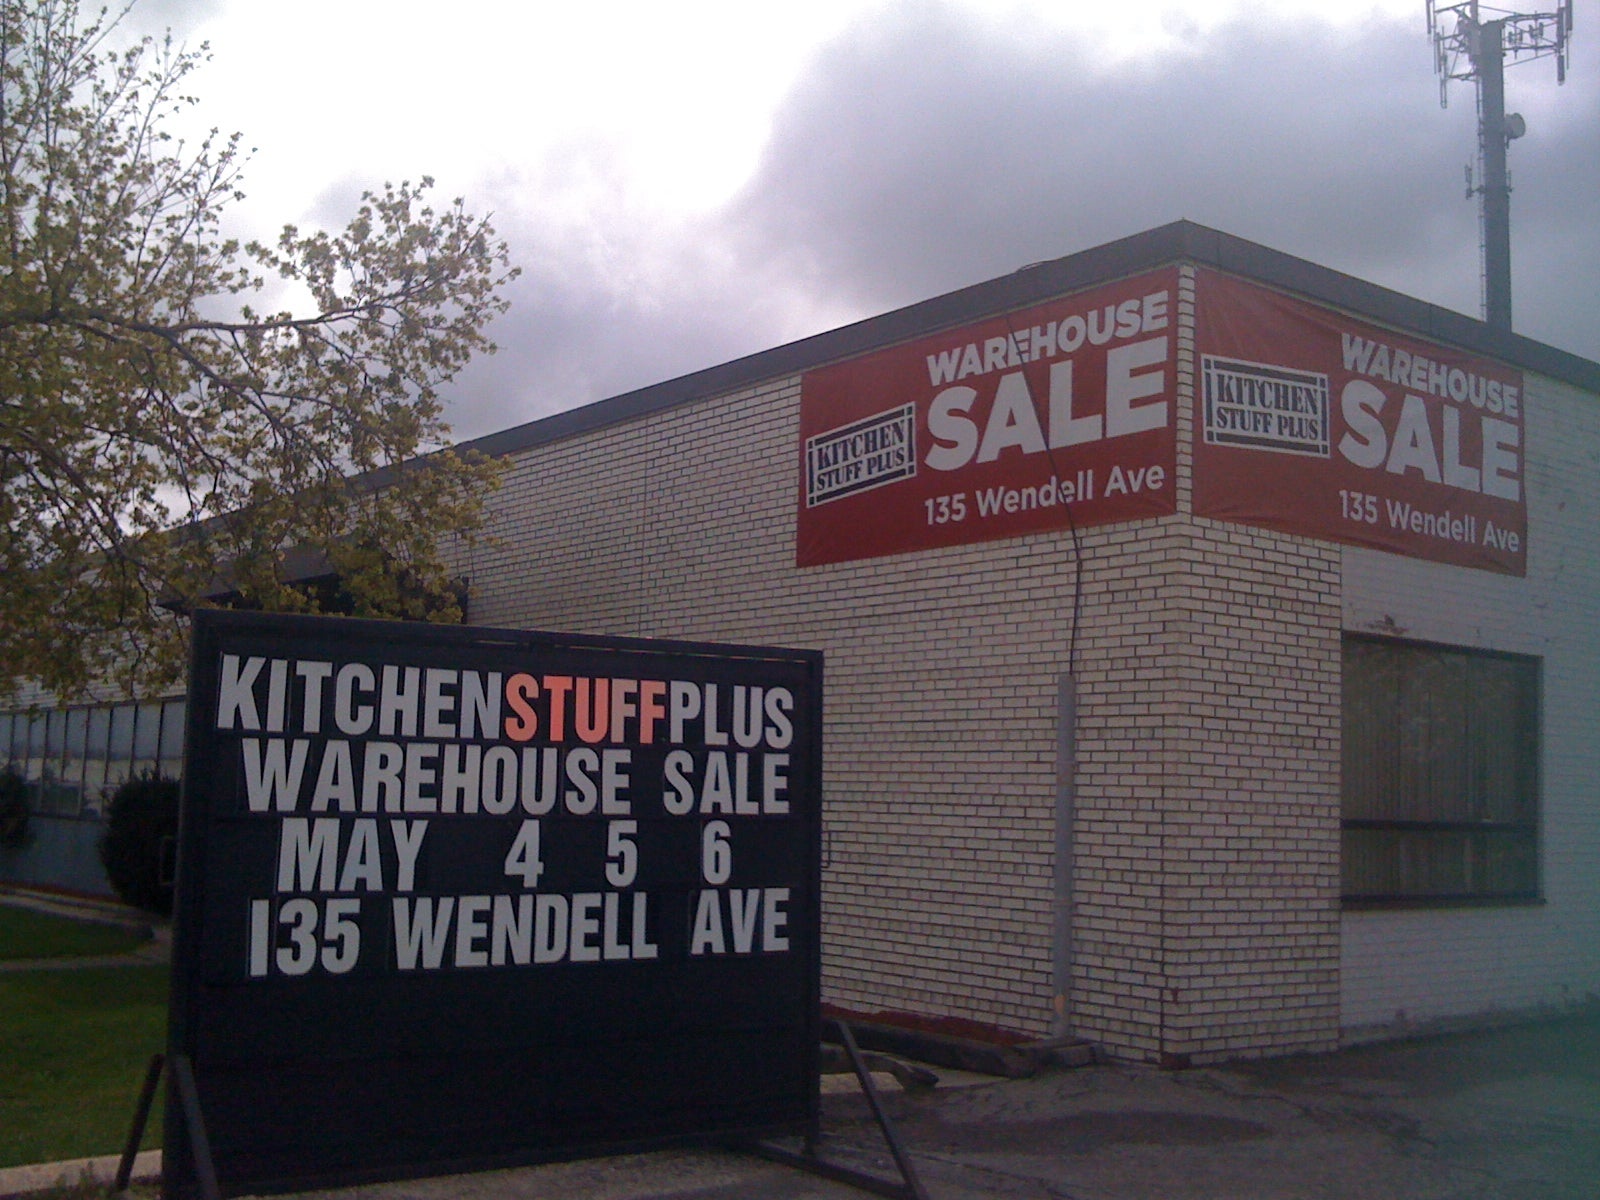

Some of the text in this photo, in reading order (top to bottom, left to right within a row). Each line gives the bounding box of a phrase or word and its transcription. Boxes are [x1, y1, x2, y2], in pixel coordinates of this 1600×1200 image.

[926, 290, 1168, 387] WAREHOUSE
[1341, 332, 1519, 418] WAREHOUSE
[924, 336, 1168, 471] SALE
[1216, 374, 1318, 416] KITCHEN
[1216, 407, 1318, 440] STUFF PLUS
[816, 447, 905, 492] STUFF PLUS
[817, 419, 905, 472] KITCHEN
[1338, 379, 1520, 502] SALE
[925, 464, 1165, 525] 135 Wendell Ave
[1339, 489, 1519, 552] 135 Wendell Ave
[242, 738, 790, 816] WAREHOUSE SALE
[277, 817, 732, 893] MAY 4 5 6
[250, 887, 790, 977] 135 WENDELL AVE
